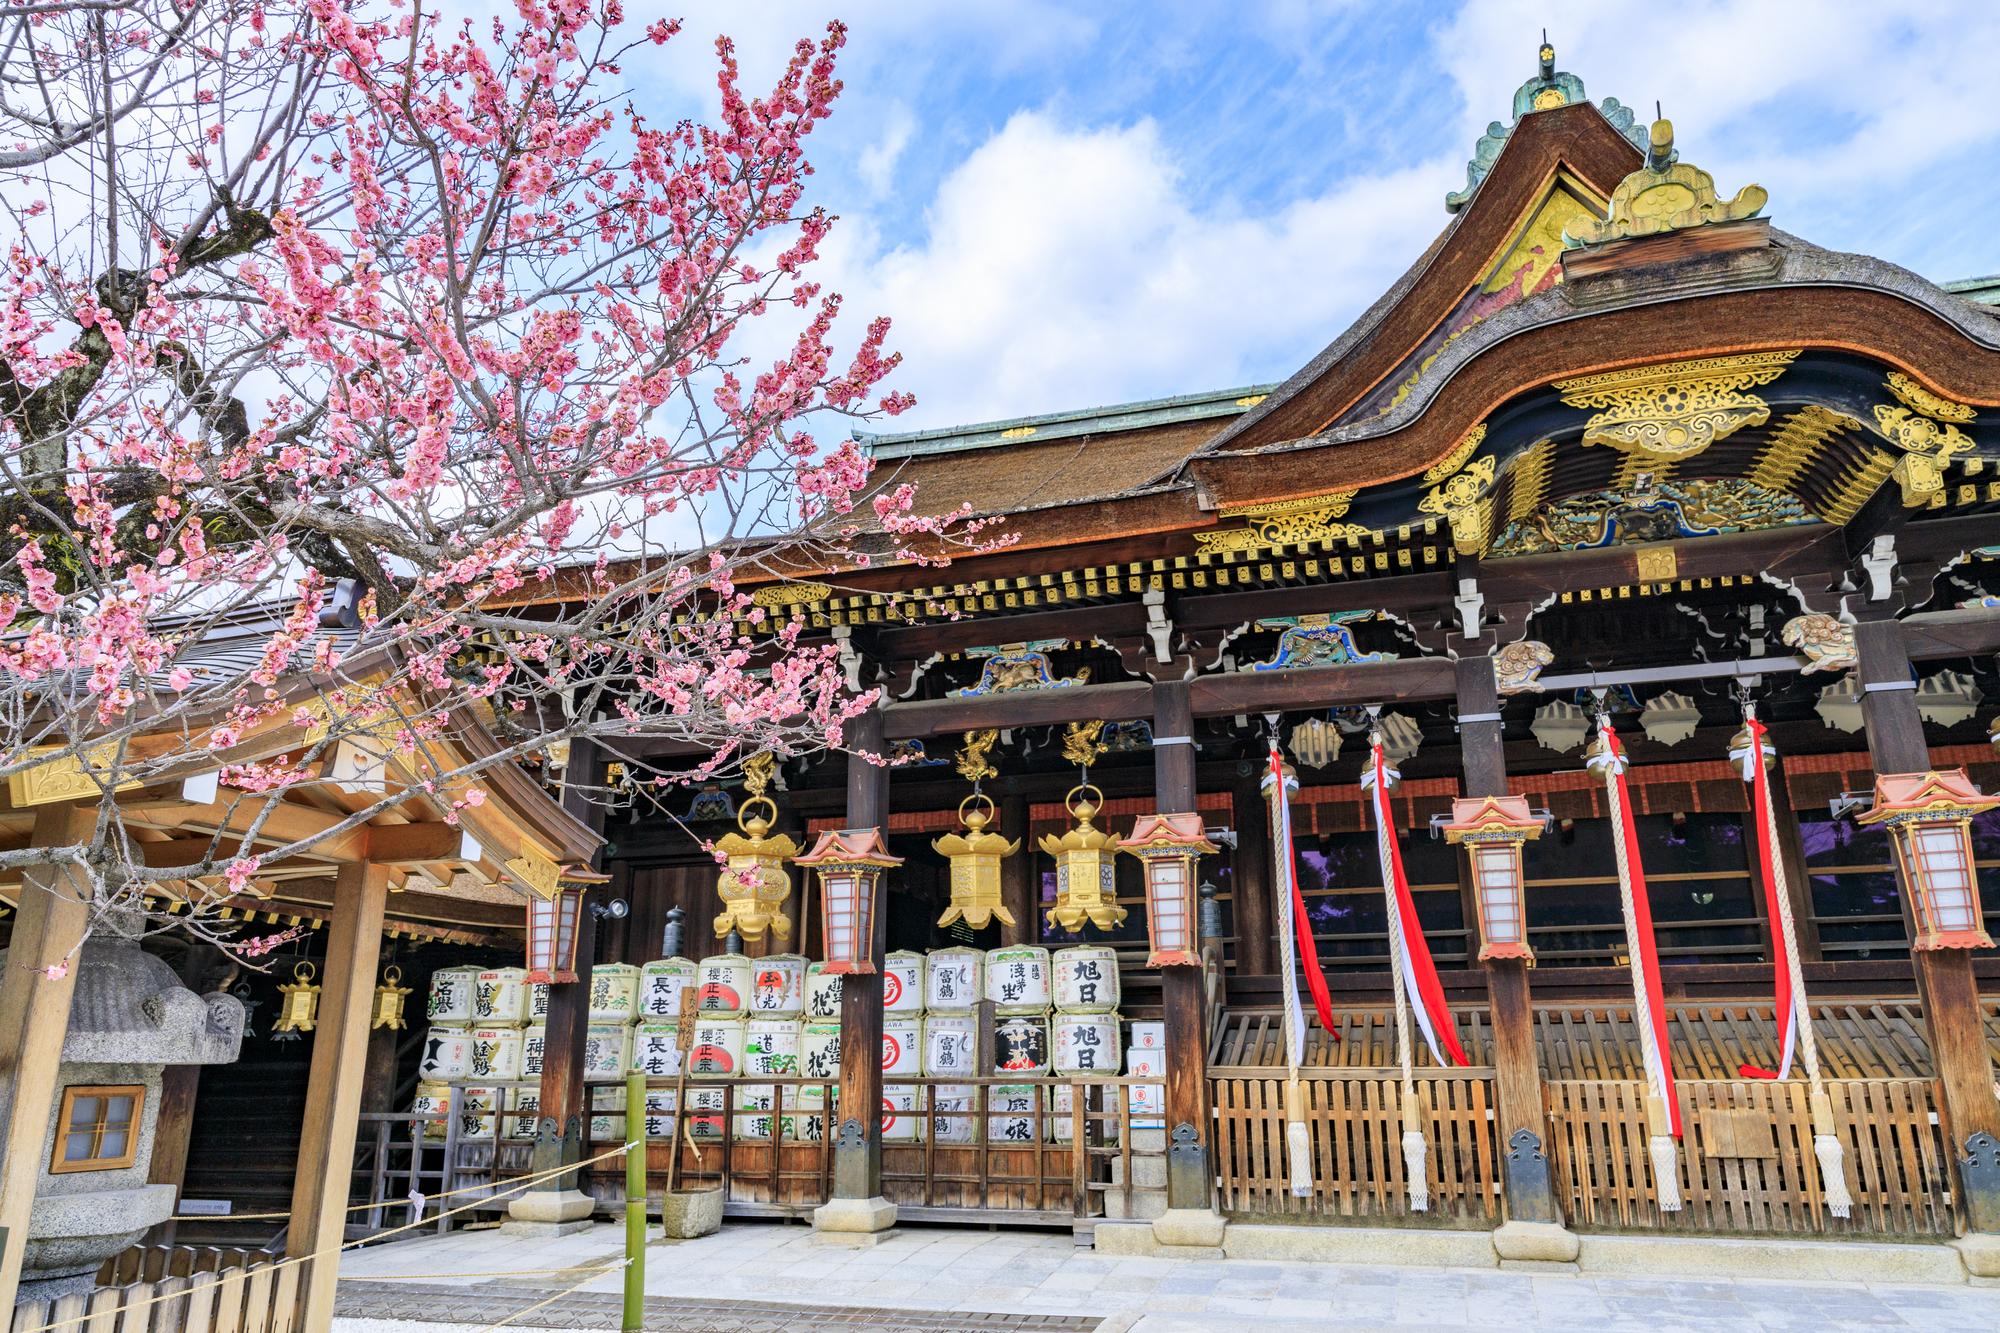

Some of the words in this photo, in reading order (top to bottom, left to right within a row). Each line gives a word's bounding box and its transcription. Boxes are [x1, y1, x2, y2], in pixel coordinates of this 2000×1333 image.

[650, 977, 672, 1015] 長老
[706, 967, 721, 1009] 櫻正宗
[763, 971, 779, 1009] 玉乃光
[939, 969, 954, 998] 富鶴
[1073, 960, 1102, 1004] 旭日
[645, 1037, 668, 1074] 長老
[699, 1029, 713, 1072] 櫻正宗
[939, 1036, 954, 1066] 富鶴
[1072, 1025, 1101, 1069] 旭日
[213, 1203, 225, 1211] only
